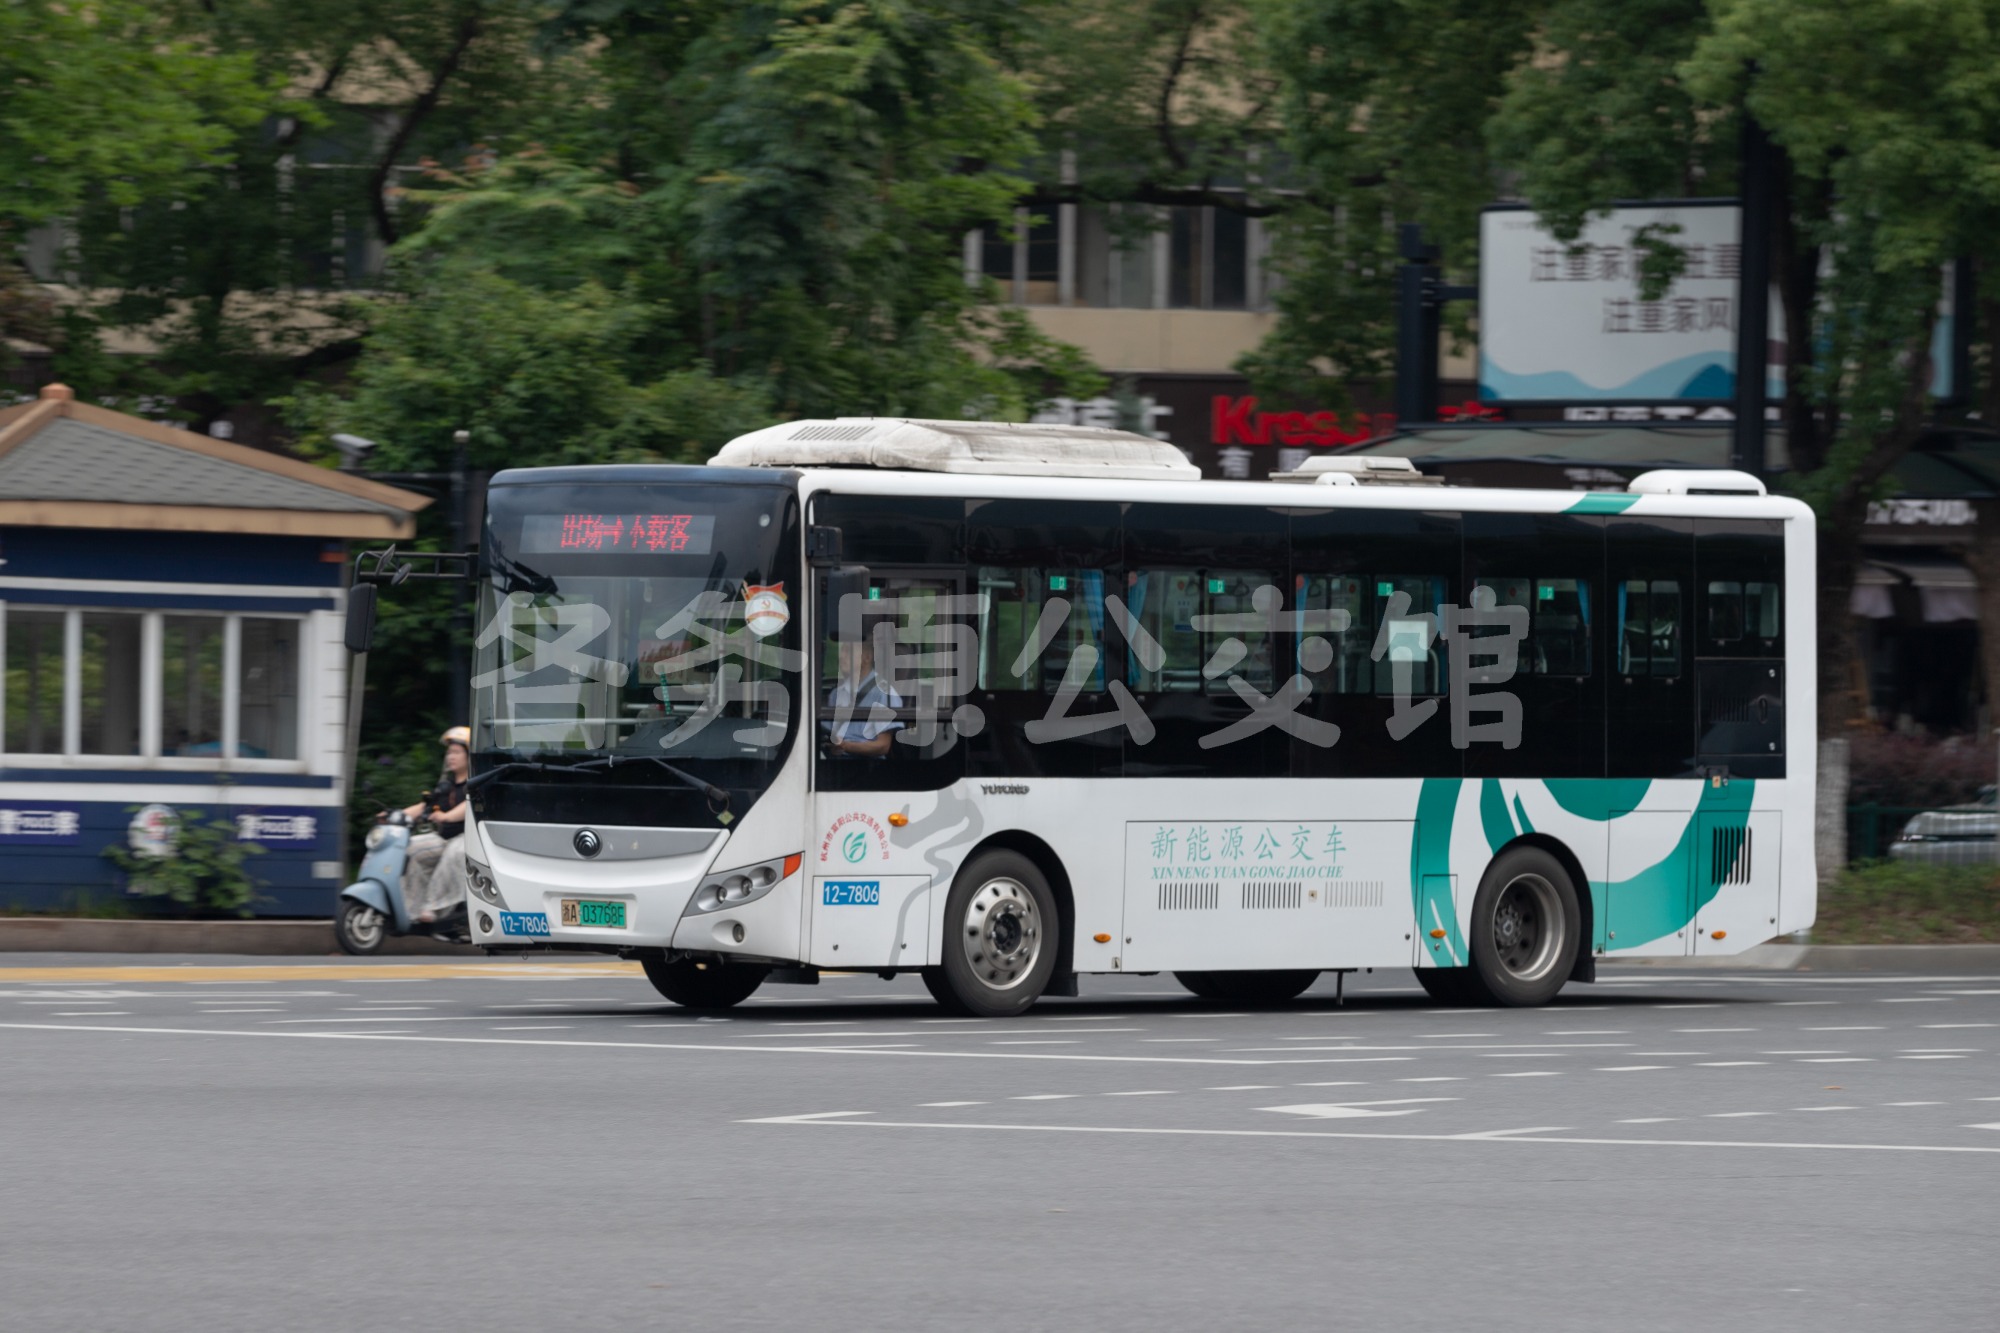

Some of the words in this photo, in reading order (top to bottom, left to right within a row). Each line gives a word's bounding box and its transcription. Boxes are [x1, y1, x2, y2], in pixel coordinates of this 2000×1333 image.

[1530, 244, 1662, 282] 注重家
[980, 783, 1031, 796] YUTONG
[1151, 824, 1347, 864] 新能源公交车
[1151, 866, 1174, 880] XIN
[1175, 866, 1211, 879] NENG
[1213, 866, 1248, 879] YUAN
[1249, 866, 1285, 879] GONG
[1286, 865, 1316, 880] JIAO
[1318, 865, 1344, 879] CHE
[824, 885, 879, 903] 12-7806
[501, 915, 550, 933] 12-7806
